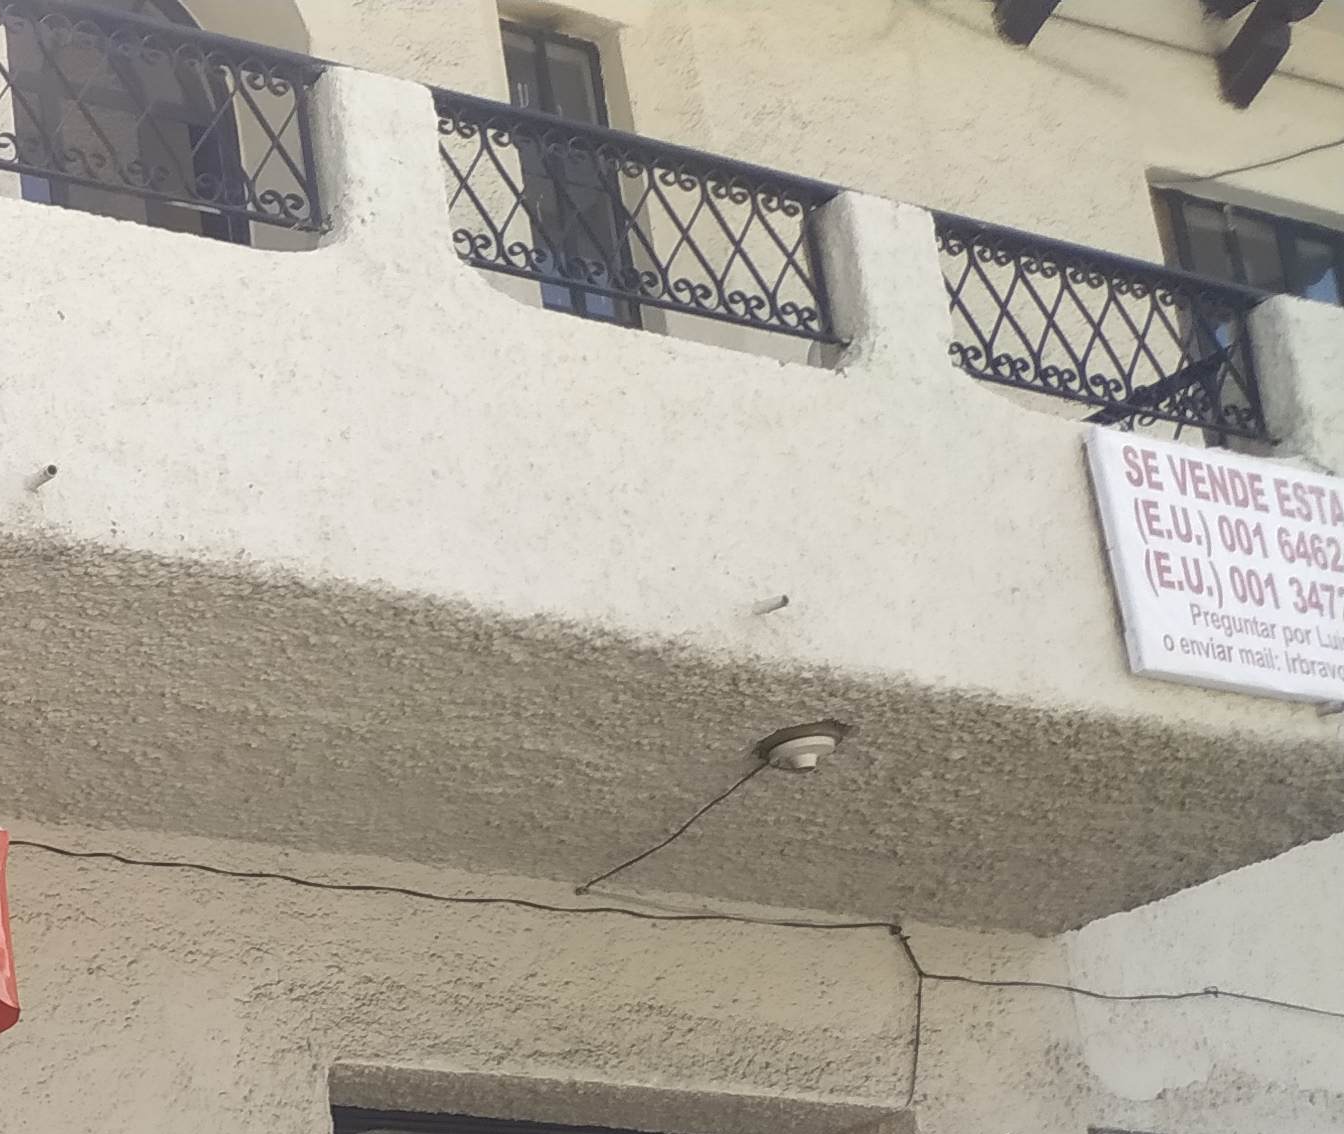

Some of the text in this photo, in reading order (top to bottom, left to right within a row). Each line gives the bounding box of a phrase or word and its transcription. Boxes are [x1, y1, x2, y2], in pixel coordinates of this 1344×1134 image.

[1122, 445, 1344, 526] SE VENDE ESTA
[1134, 497, 1344, 573] (E.U.) 001 6462
[1145, 549, 1223, 609] (E.U.)
[1229, 566, 1280, 610] 001
[1163, 634, 1174, 651] o
[1180, 637, 1233, 663] enviar
[1239, 648, 1280, 671] mail:
[1189, 603, 1276, 637] Preguntar
[1282, 626, 1311, 647] por
